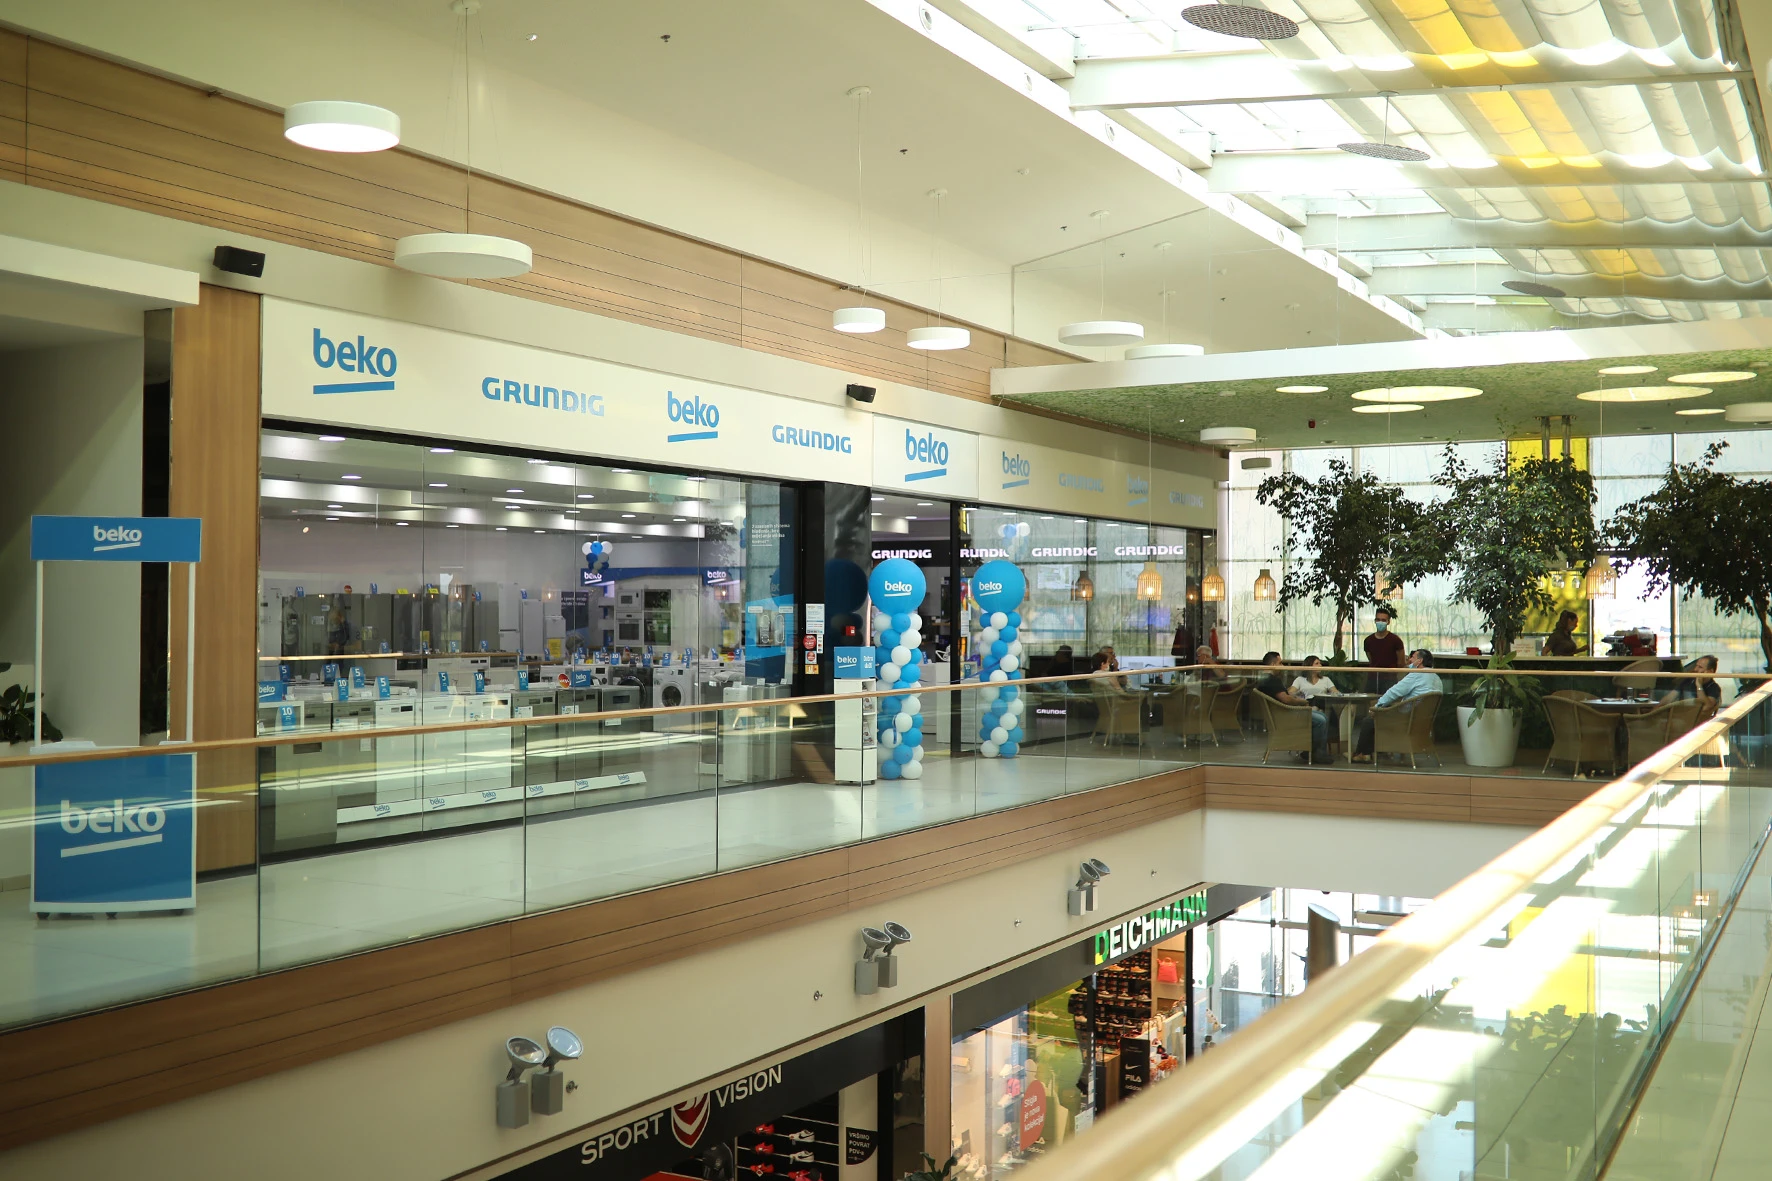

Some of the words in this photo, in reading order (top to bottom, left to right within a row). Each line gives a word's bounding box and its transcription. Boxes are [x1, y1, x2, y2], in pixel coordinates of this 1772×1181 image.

[312, 327, 397, 378] beko
[481, 376, 605, 417] GRUNDIG
[667, 390, 720, 428] beko
[772, 424, 852, 454] GRUNDIG
[905, 428, 949, 466] beko
[1002, 451, 1030, 477] beko
[1058, 472, 1105, 493] GRUNDIG
[1127, 472, 1149, 495] beko
[1169, 491, 1204, 509] GRUNDIG
[93, 525, 142, 543] beko
[871, 549, 932, 559] GRUNDIG
[1031, 546, 1098, 557] GRUNDIG
[1114, 545, 1184, 556] GRUNDIG
[707, 570, 727, 579] beko
[884, 580, 913, 593] beko
[978, 581, 1003, 591] beko
[836, 655, 858, 664] beko
[281, 666, 287, 674] 5
[325, 665, 331, 673] 5
[355, 668, 361, 677] 5
[380, 677, 387, 687] 5
[441, 672, 447, 681] 5
[338, 679, 347, 687] 10
[282, 707, 292, 716] 10
[482, 790, 497, 798] beko
[429, 797, 445, 806] beko
[373, 804, 391, 812] beko
[60, 798, 166, 835] beko
[1095, 889, 1208, 966] DEICHMANN
[1125, 1074, 1142, 1083] FILA
[581, 1113, 664, 1165] SPORT
[715, 1064, 782, 1108] VISION
[1024, 1111, 1029, 1122] je
[849, 1139, 870, 1148] POVRAT
